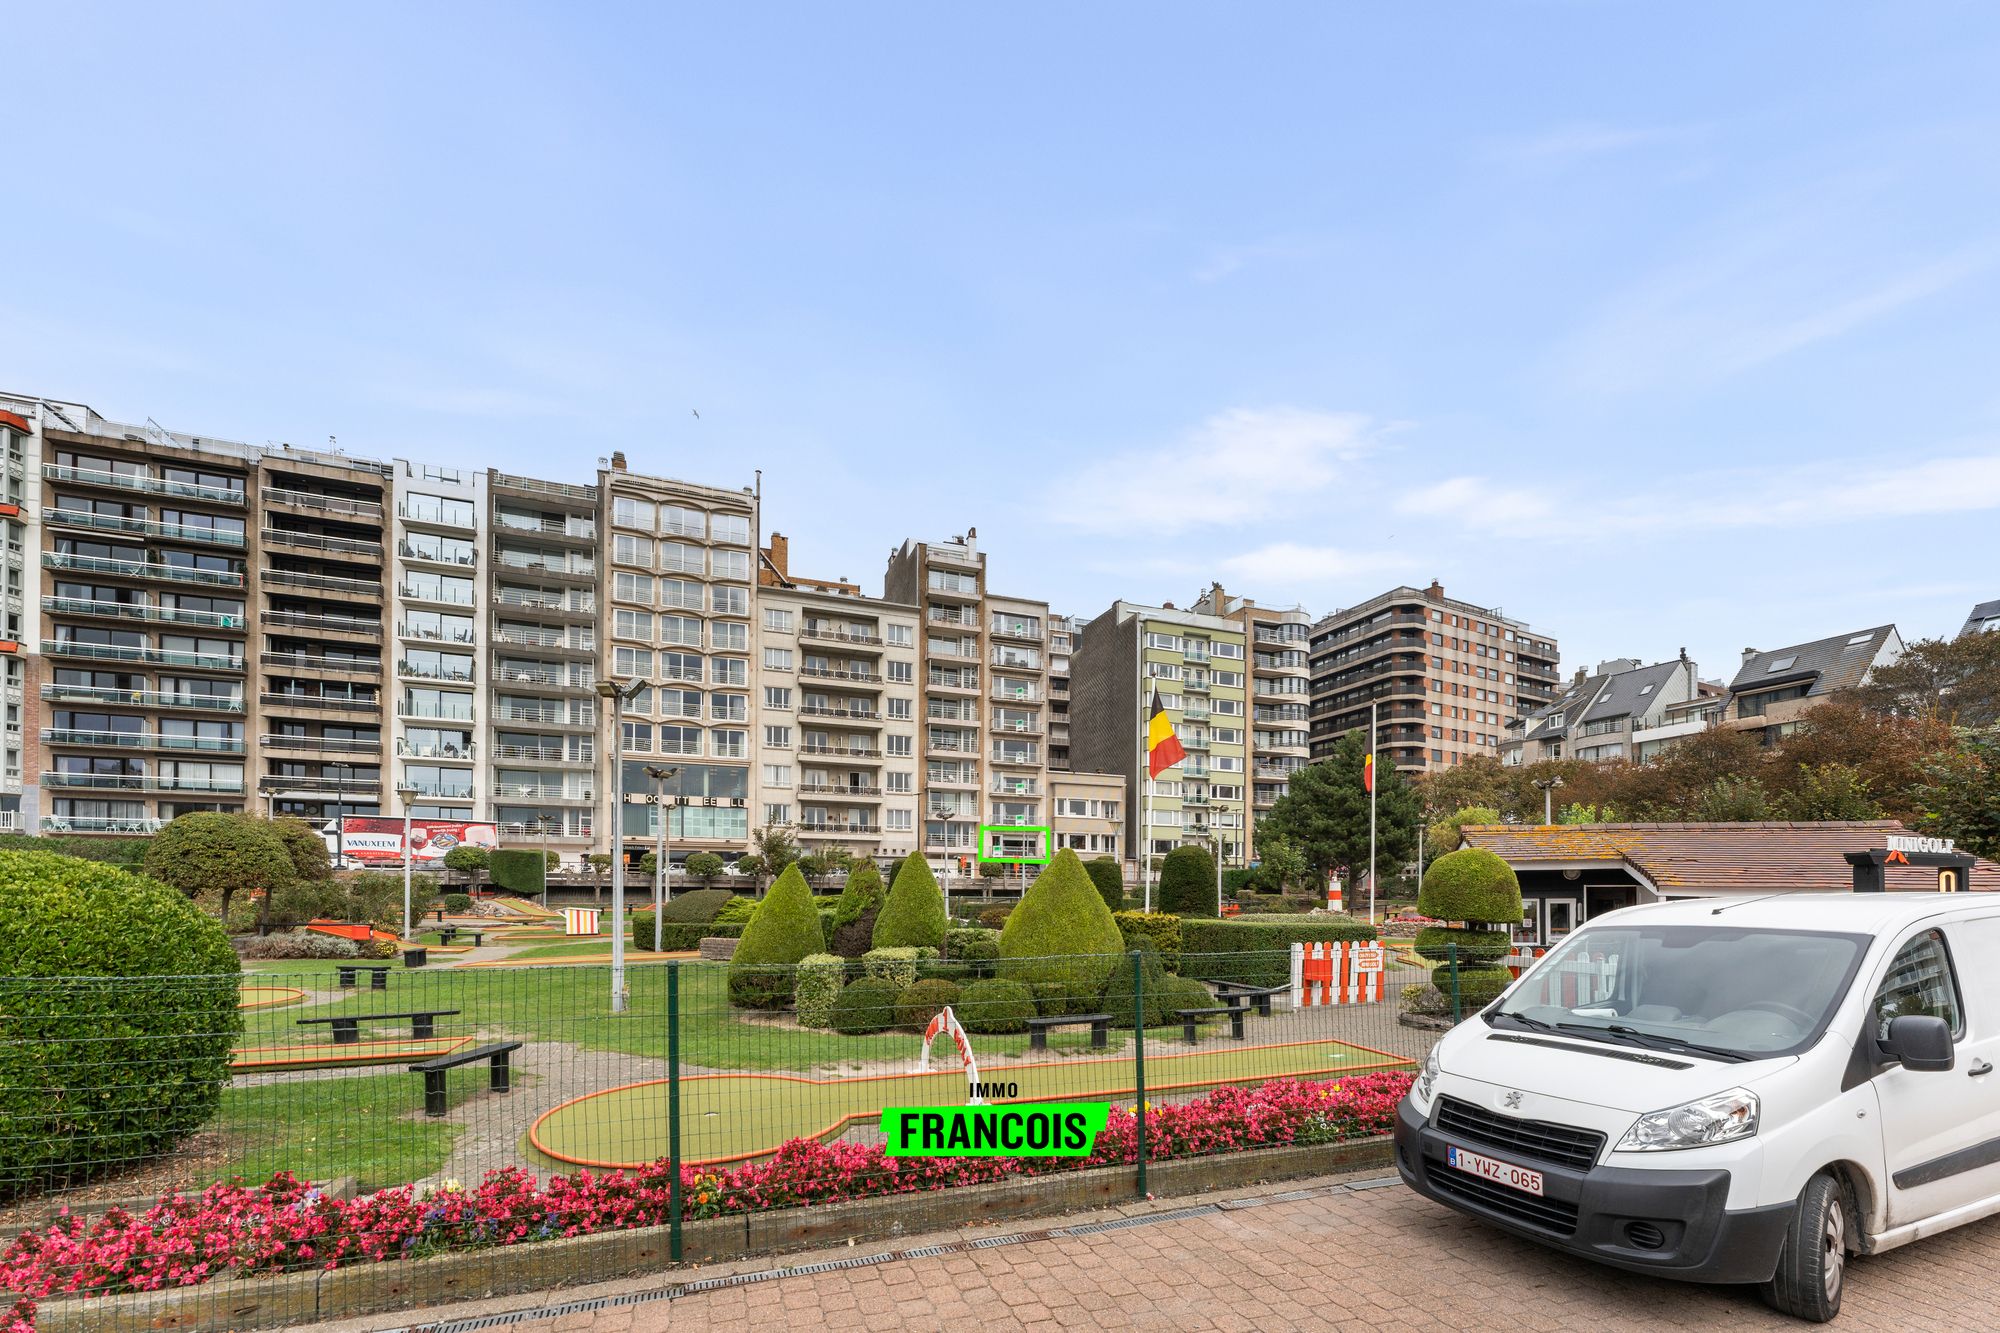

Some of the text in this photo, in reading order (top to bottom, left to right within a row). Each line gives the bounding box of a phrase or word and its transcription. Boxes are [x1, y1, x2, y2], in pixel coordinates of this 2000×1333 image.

[347, 840, 396, 848] VANUXEEM
[1886, 835, 1955, 854] MINIGOLF
[1458, 1152, 1540, 1192] 1-YWZ-065
